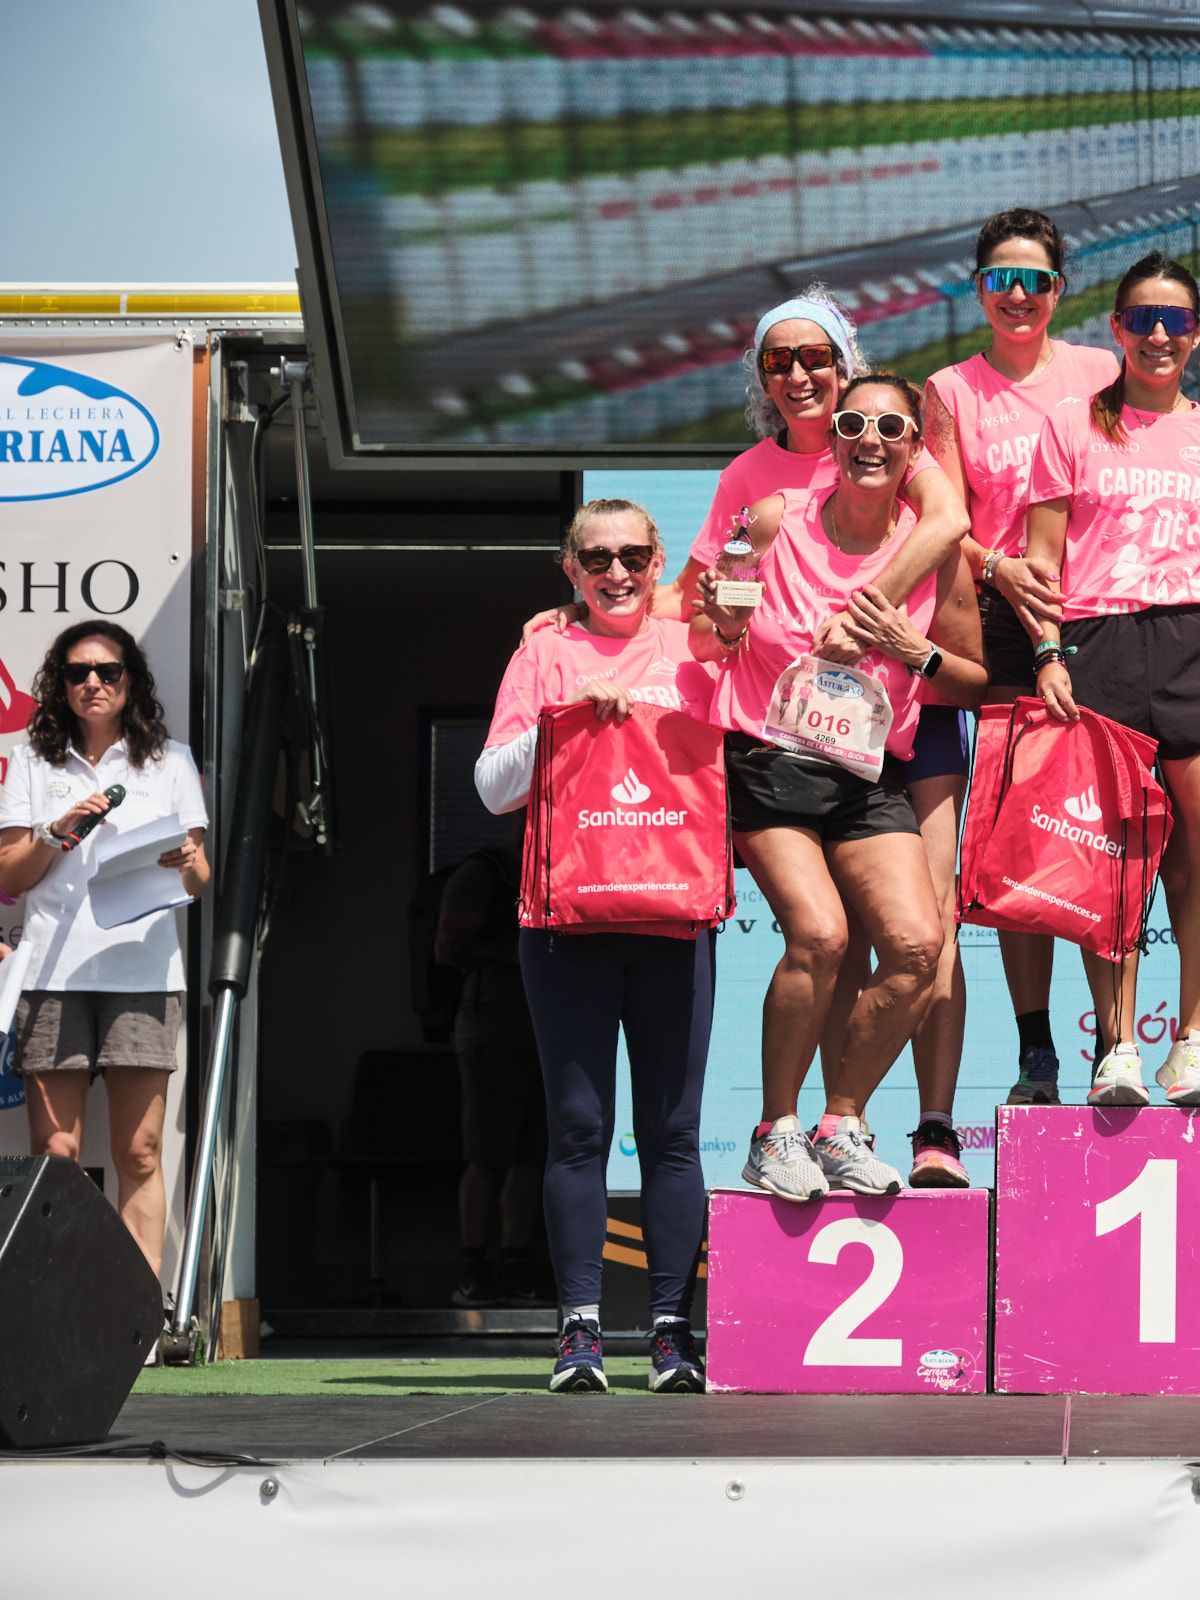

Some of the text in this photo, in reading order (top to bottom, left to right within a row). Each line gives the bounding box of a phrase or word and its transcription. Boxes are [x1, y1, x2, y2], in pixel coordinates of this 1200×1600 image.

[26, 407, 125, 420] LECHERA
[1150, 509, 1183, 551] DE
[0, 560, 139, 614] SHO
[1142, 567, 1170, 600] LA
[808, 711, 851, 736] 016
[814, 733, 836, 745] 4269
[578, 807, 688, 829] Santander
[578, 881, 690, 895] santanderexperiences.es
[1002, 875, 1102, 923] santanderexperiences.es
[976, 929, 998, 938] SCIEN
[7, 1090, 25, 1105] ALP
[699, 1138, 736, 1158] ankyo
[954, 1127, 995, 1154] COSM
[1096, 1159, 1177, 1343] 1
[803, 1218, 903, 1367] 2
[916, 1366, 949, 1376] Carrera
[934, 1374, 960, 1391] Mujer
